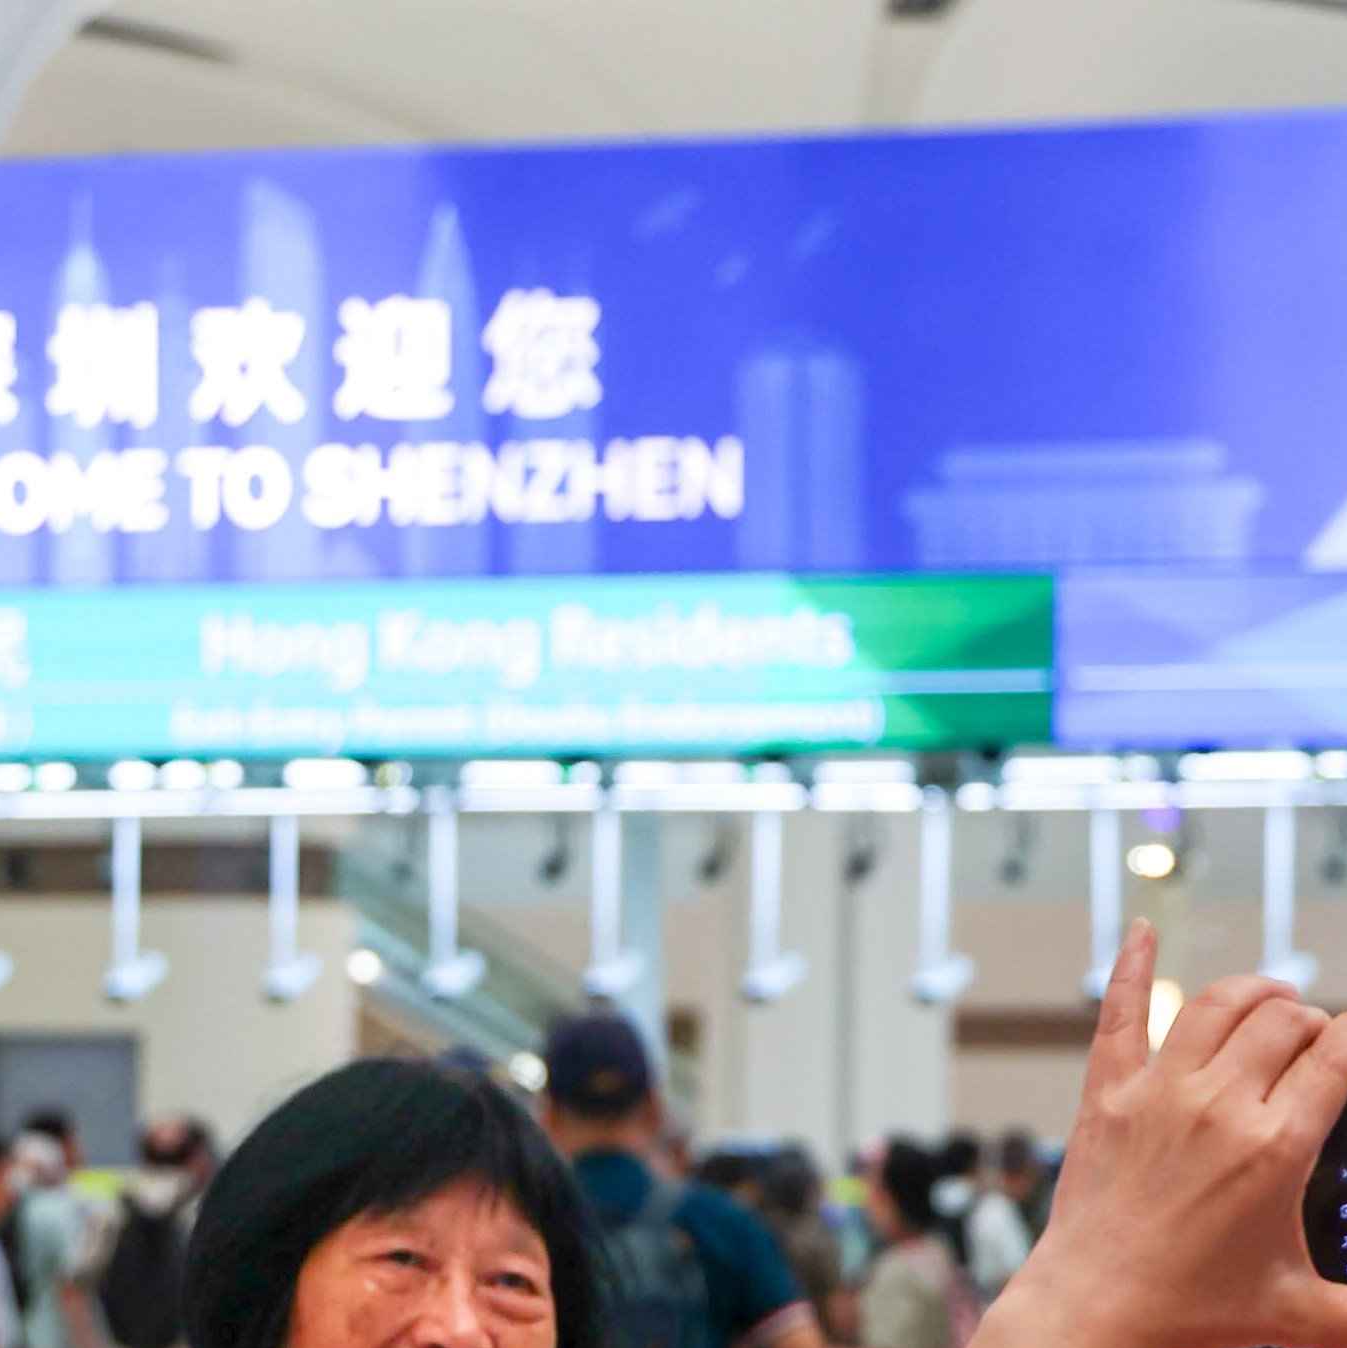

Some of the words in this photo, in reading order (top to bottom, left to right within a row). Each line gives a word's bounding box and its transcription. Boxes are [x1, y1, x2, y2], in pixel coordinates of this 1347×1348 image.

[176, 445, 295, 531] TO
[301, 434, 745, 529] SHENZHEN
[200, 611, 371, 693] Hong
[377, 608, 543, 691] Kong
[548, 602, 852, 672] Residents
